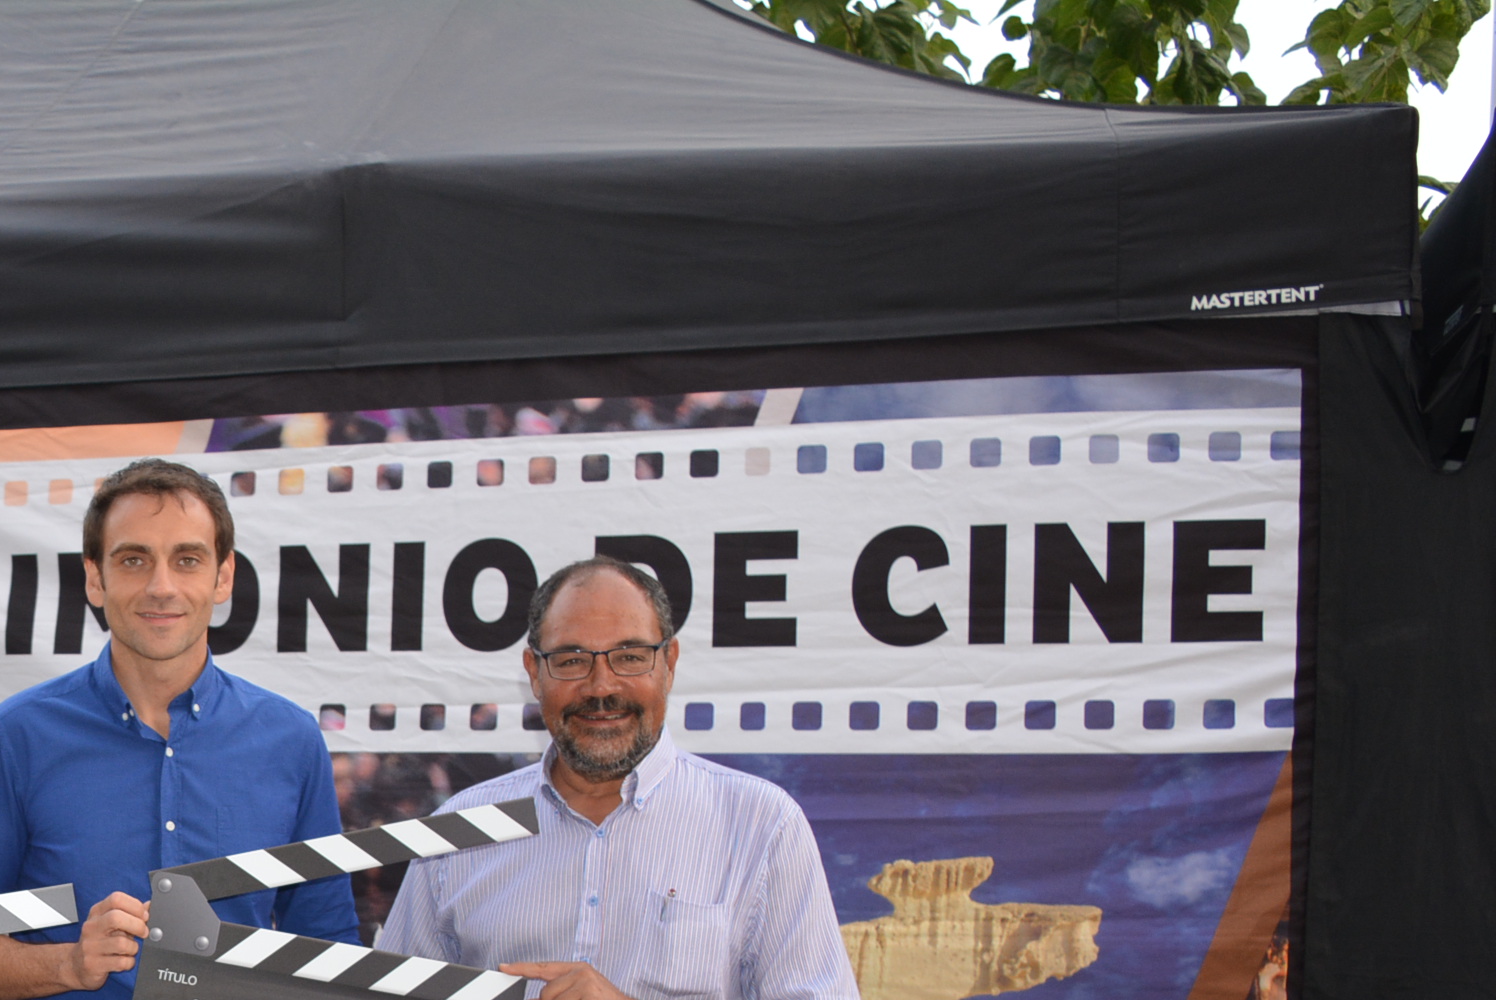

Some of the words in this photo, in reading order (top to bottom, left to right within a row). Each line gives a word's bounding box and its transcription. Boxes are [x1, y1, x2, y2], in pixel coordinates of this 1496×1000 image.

[595, 528, 799, 648] DE
[851, 518, 1267, 648] CINE
[157, 967, 198, 986] TÍTULO
